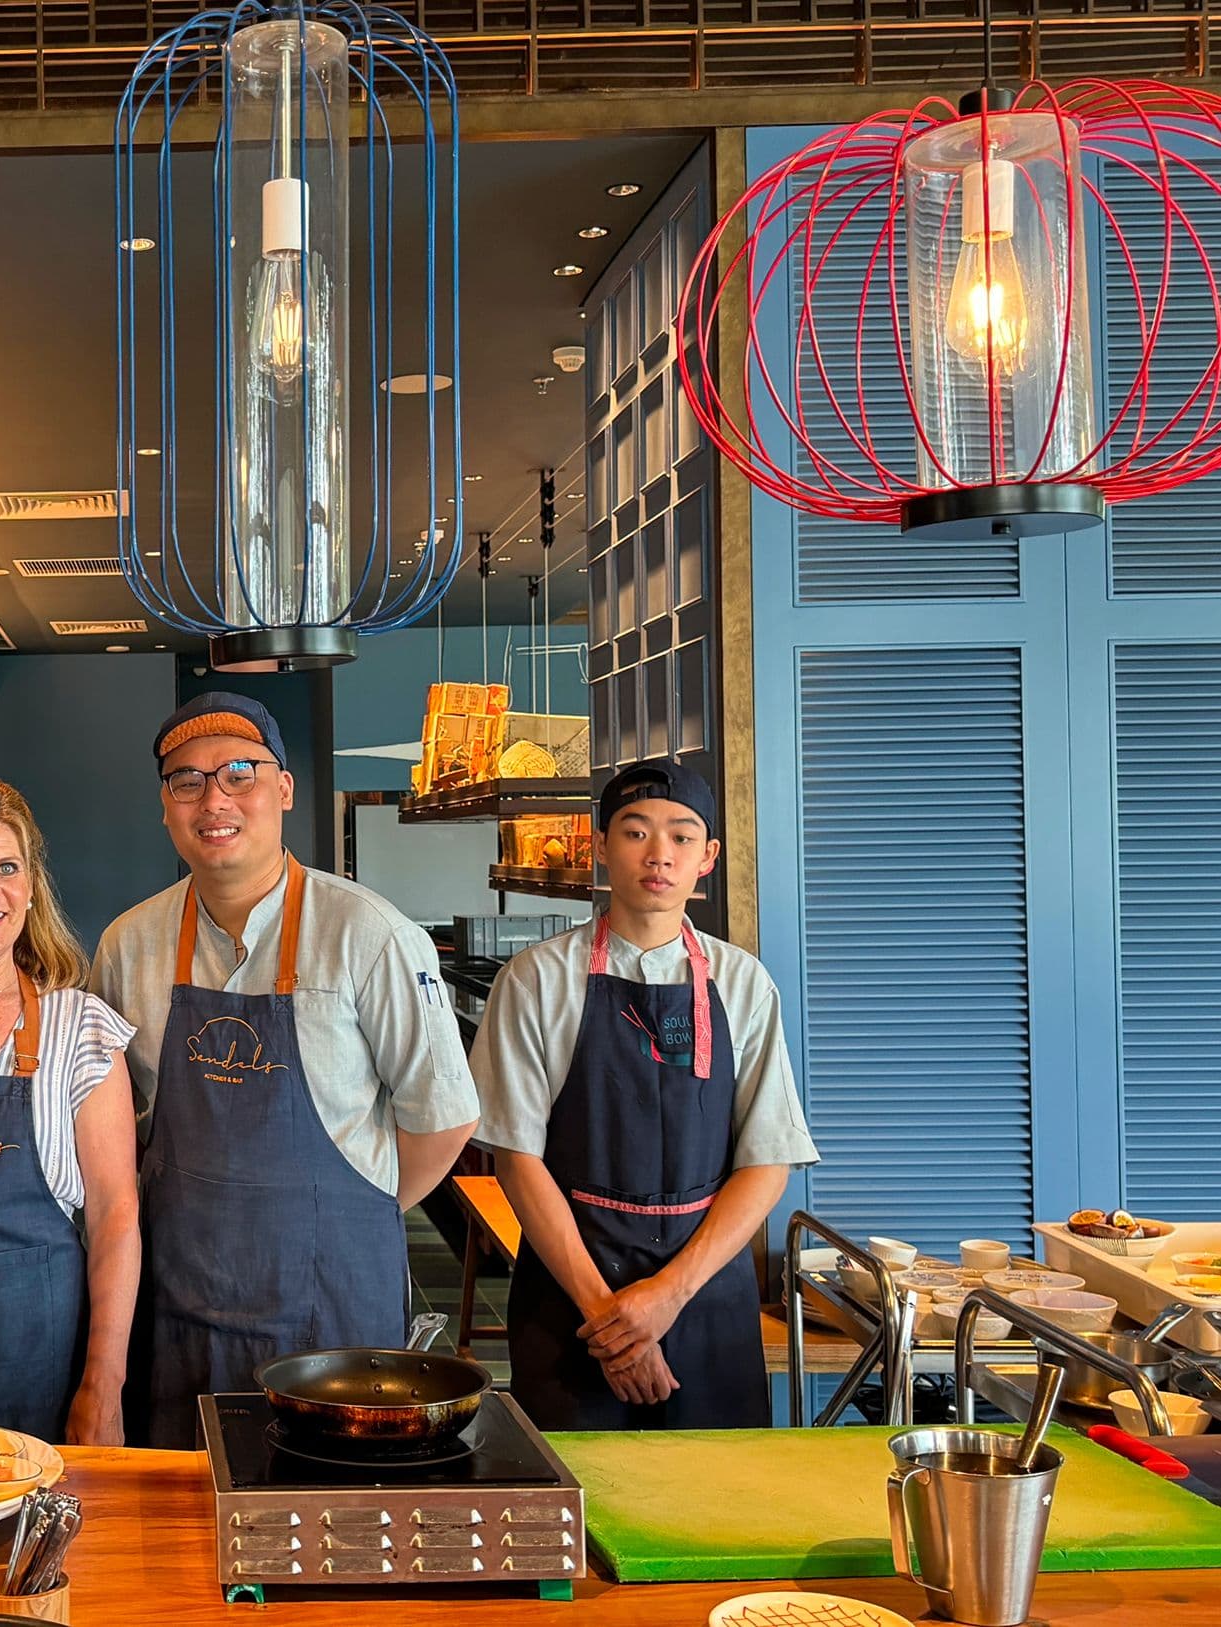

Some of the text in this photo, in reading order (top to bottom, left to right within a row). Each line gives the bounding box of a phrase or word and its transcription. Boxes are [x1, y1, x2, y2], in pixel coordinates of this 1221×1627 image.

[663, 1016, 692, 1029] SOUL
[665, 1031, 692, 1045] BOW
[186, 1035, 290, 1074] Sandals
